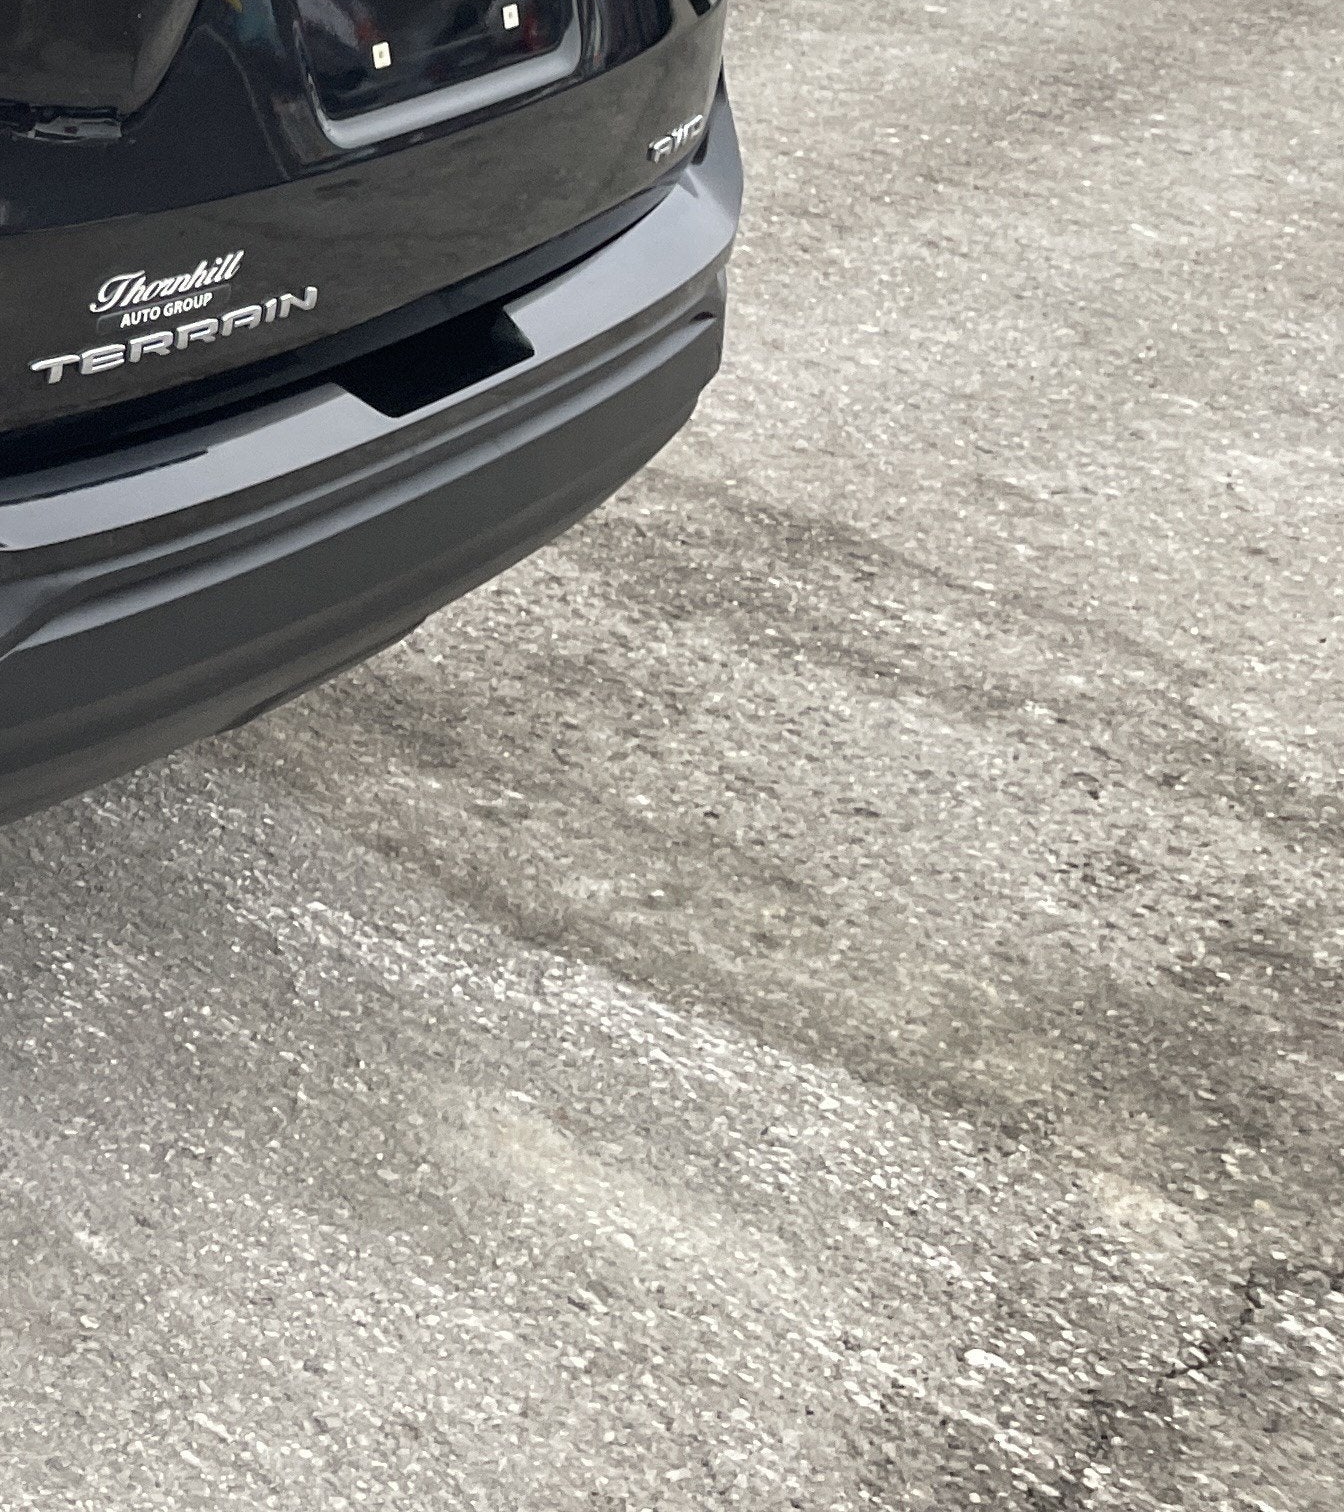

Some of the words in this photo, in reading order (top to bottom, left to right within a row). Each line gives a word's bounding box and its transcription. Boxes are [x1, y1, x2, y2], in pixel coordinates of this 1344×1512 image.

[89, 250, 245, 314] Thornhill
[120, 306, 160, 329] AUTO
[163, 292, 213, 318] GROUP
[30, 285, 318, 384] TERRAIN
